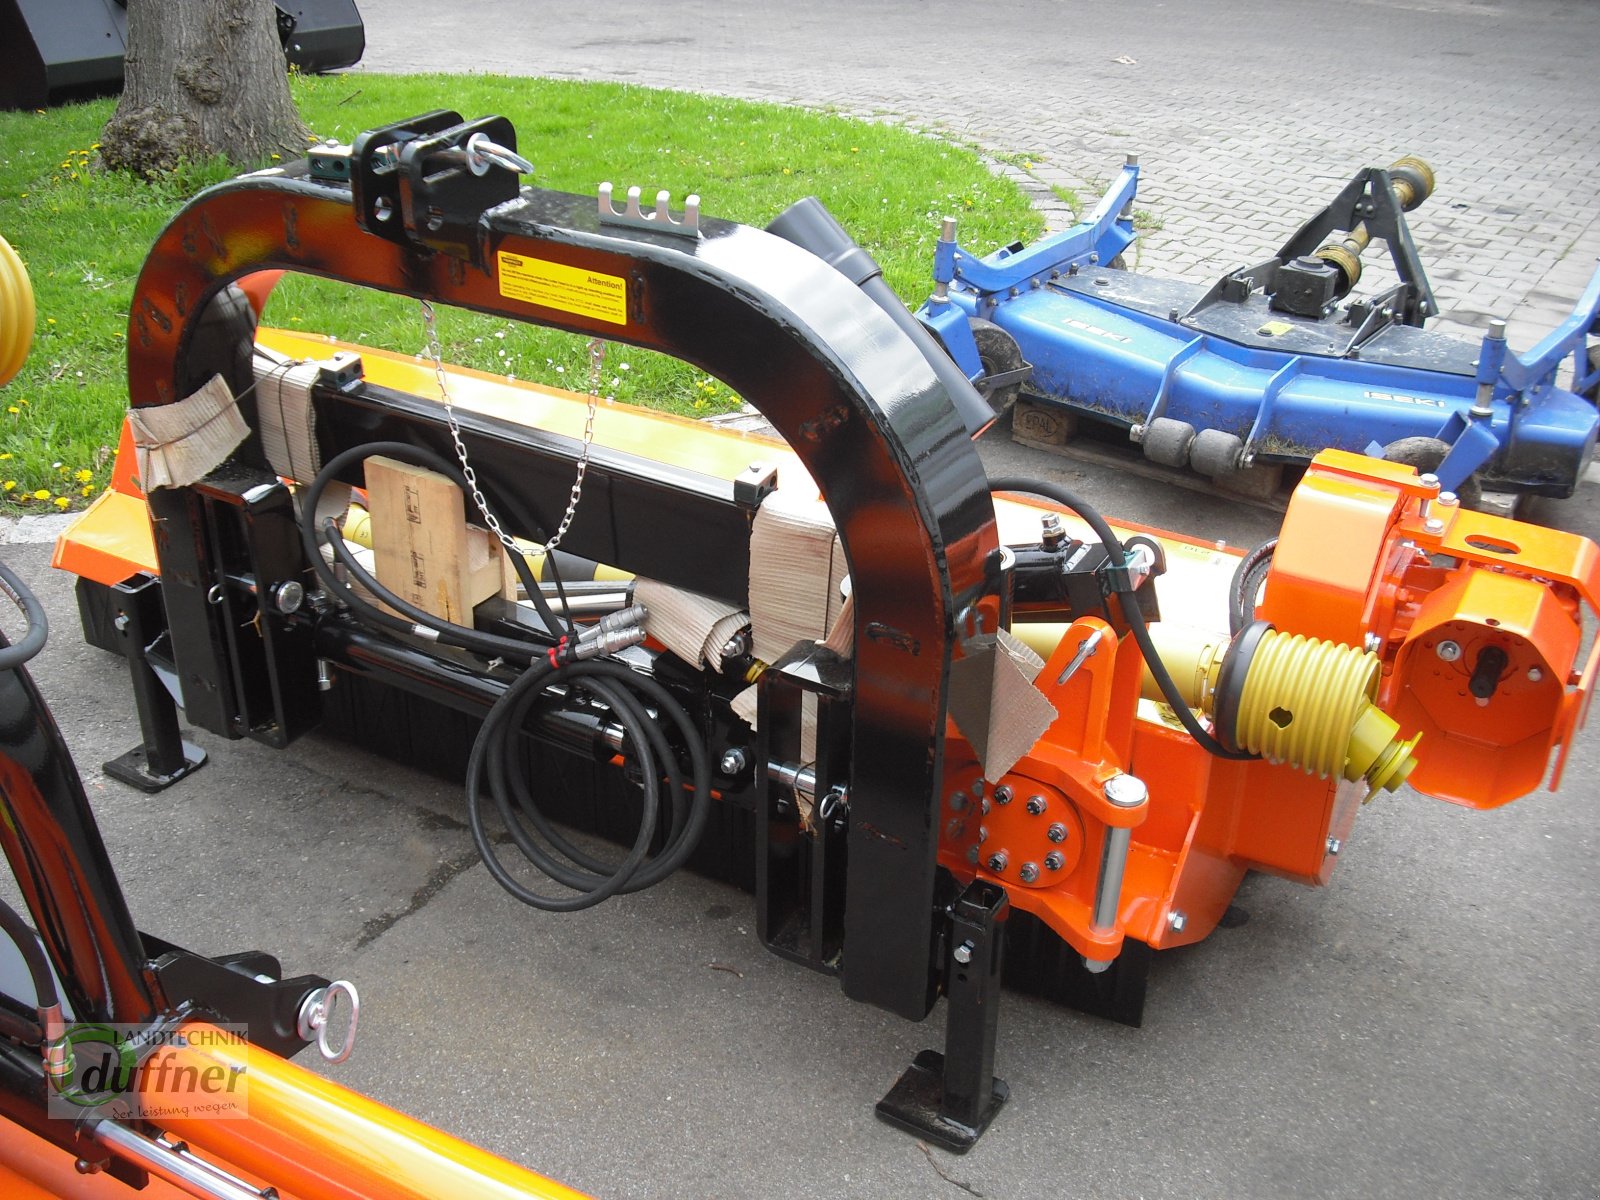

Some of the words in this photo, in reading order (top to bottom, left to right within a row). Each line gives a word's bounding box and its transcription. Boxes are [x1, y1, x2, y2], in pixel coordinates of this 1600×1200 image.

[588, 276, 623, 290] Attention!
[1062, 318, 1132, 343] ISEKI
[1364, 391, 1445, 407] ISEKI
